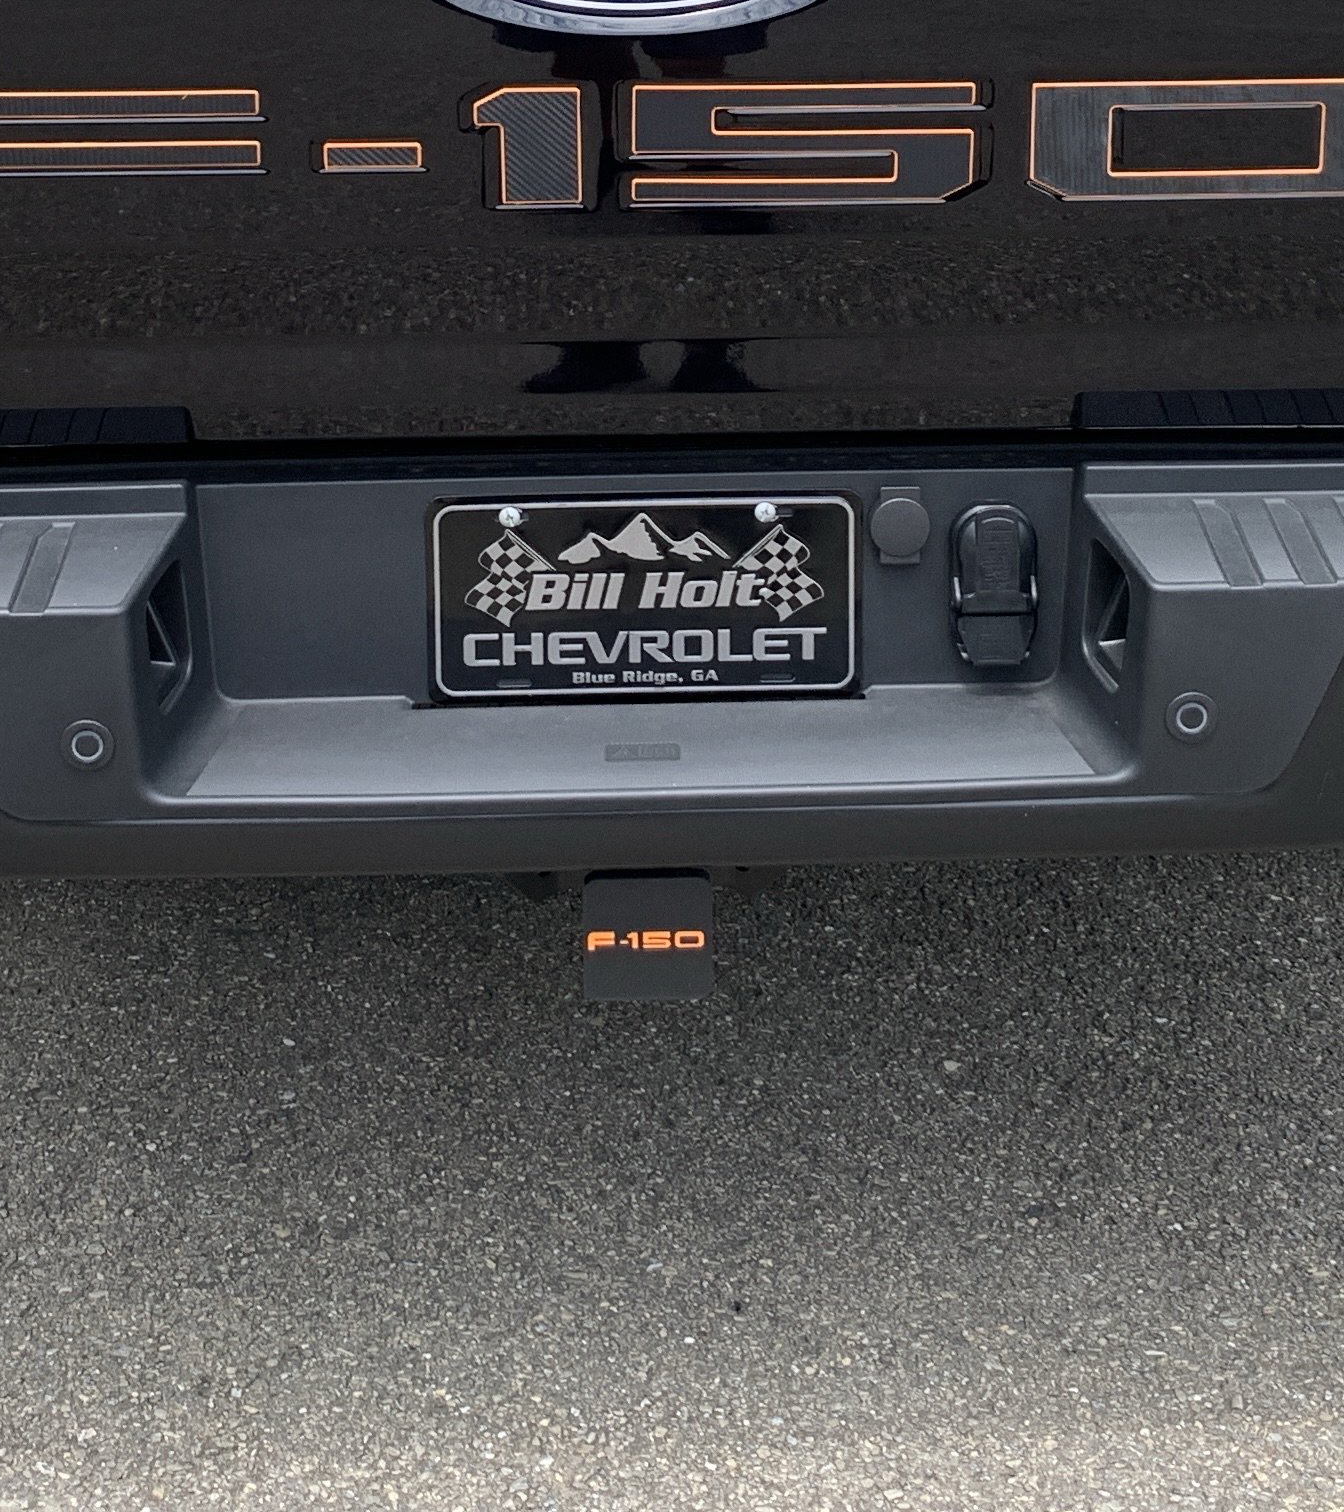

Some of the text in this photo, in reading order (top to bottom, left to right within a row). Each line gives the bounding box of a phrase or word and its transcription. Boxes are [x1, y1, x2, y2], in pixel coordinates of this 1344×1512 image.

[524, 570, 766, 611] Bill Holt
[462, 626, 828, 667] CHEVROLET
[572, 669, 720, 685] Blue Ridge, GA
[587, 930, 705, 951] F-150
